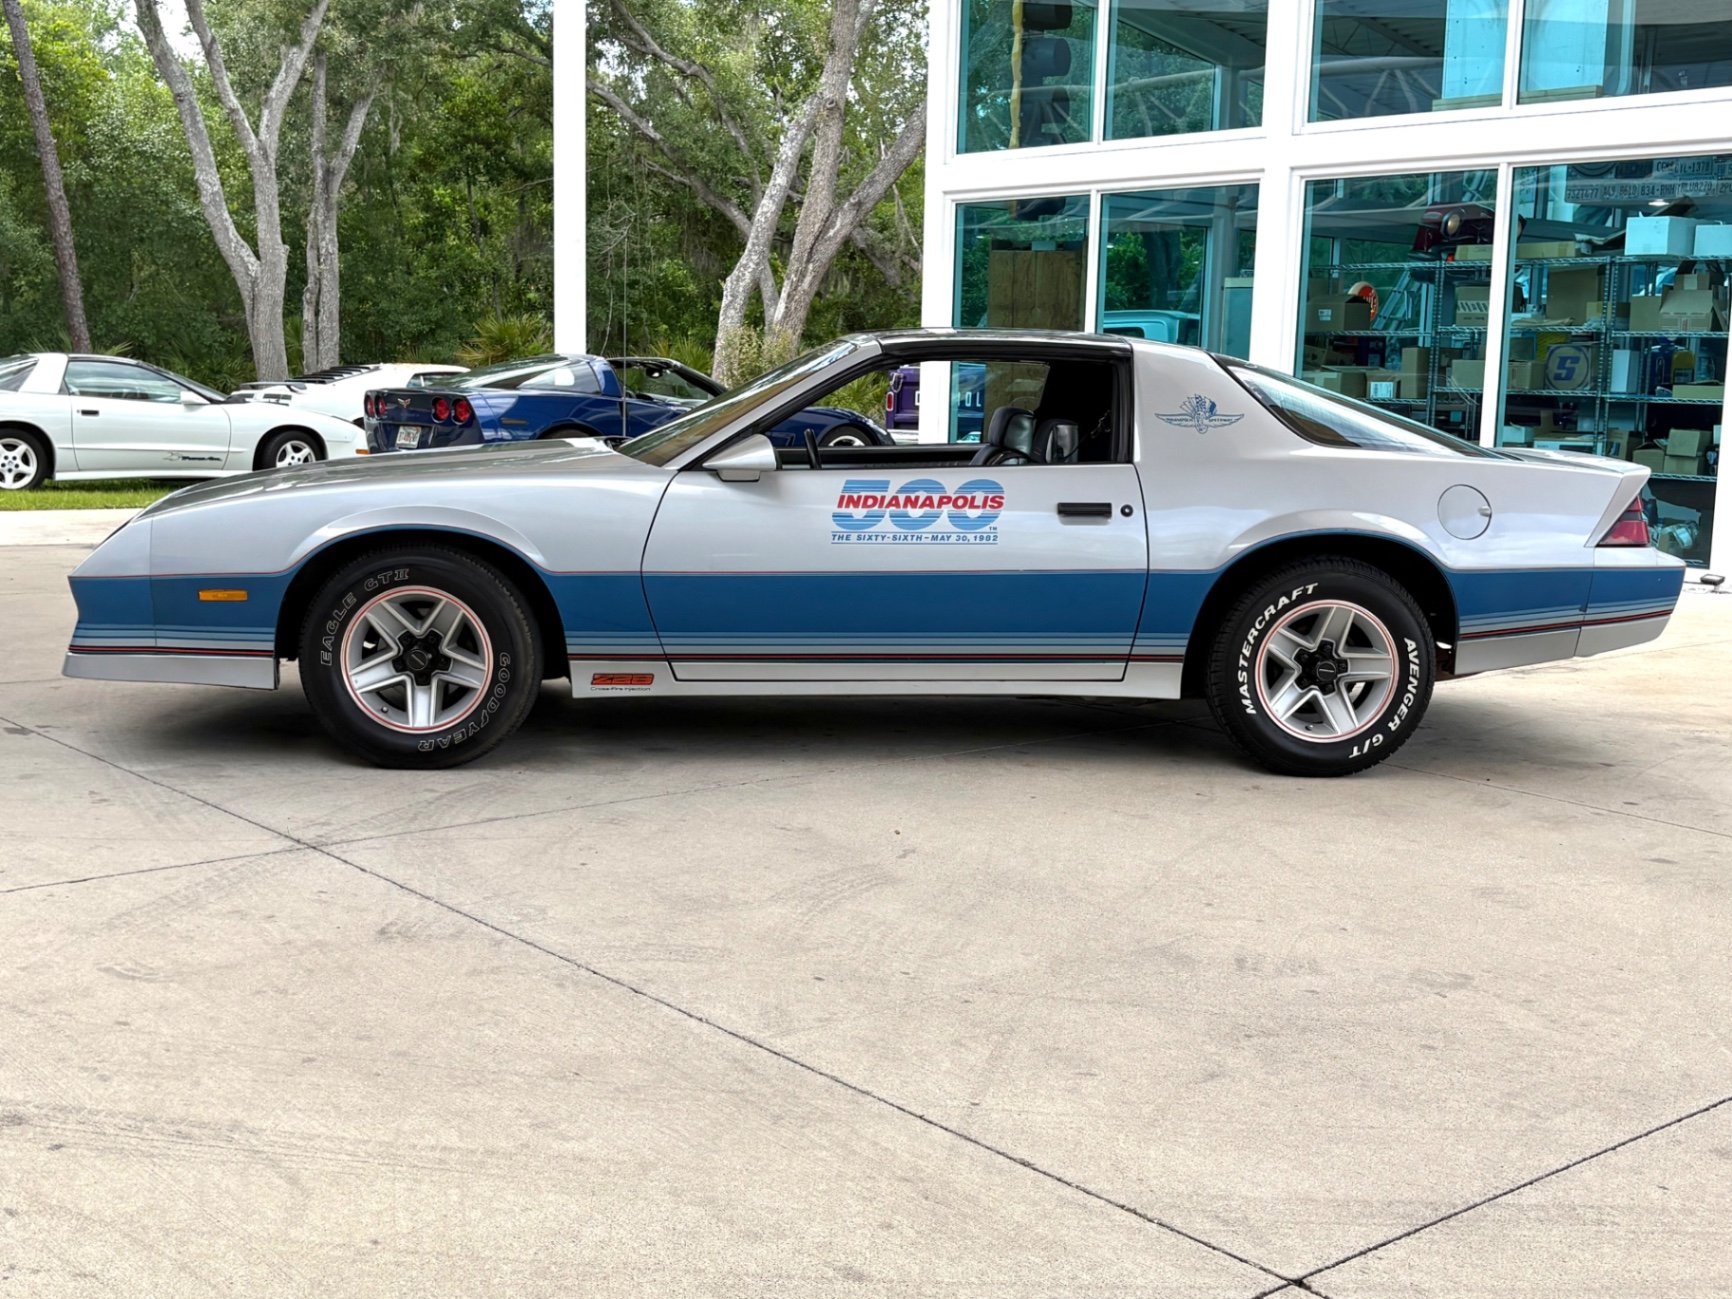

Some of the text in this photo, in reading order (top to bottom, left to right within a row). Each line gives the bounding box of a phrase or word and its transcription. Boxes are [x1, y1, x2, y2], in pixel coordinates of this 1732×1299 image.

[1553, 356, 1580, 381] S
[832, 478, 1005, 531] 500
[837, 494, 1005, 509] INDIANAPOLIS
[832, 533, 852, 542] THE
[955, 534, 970, 543] 30,
[973, 534, 999, 542] 1982
[320, 592, 357, 666] EAGLE
[1238, 582, 1319, 715] MASTERCRAFT
[418, 652, 511, 752] GOODYEAR
[591, 673, 654, 685] Z28
[1349, 637, 1421, 758] AVENGER G/T
